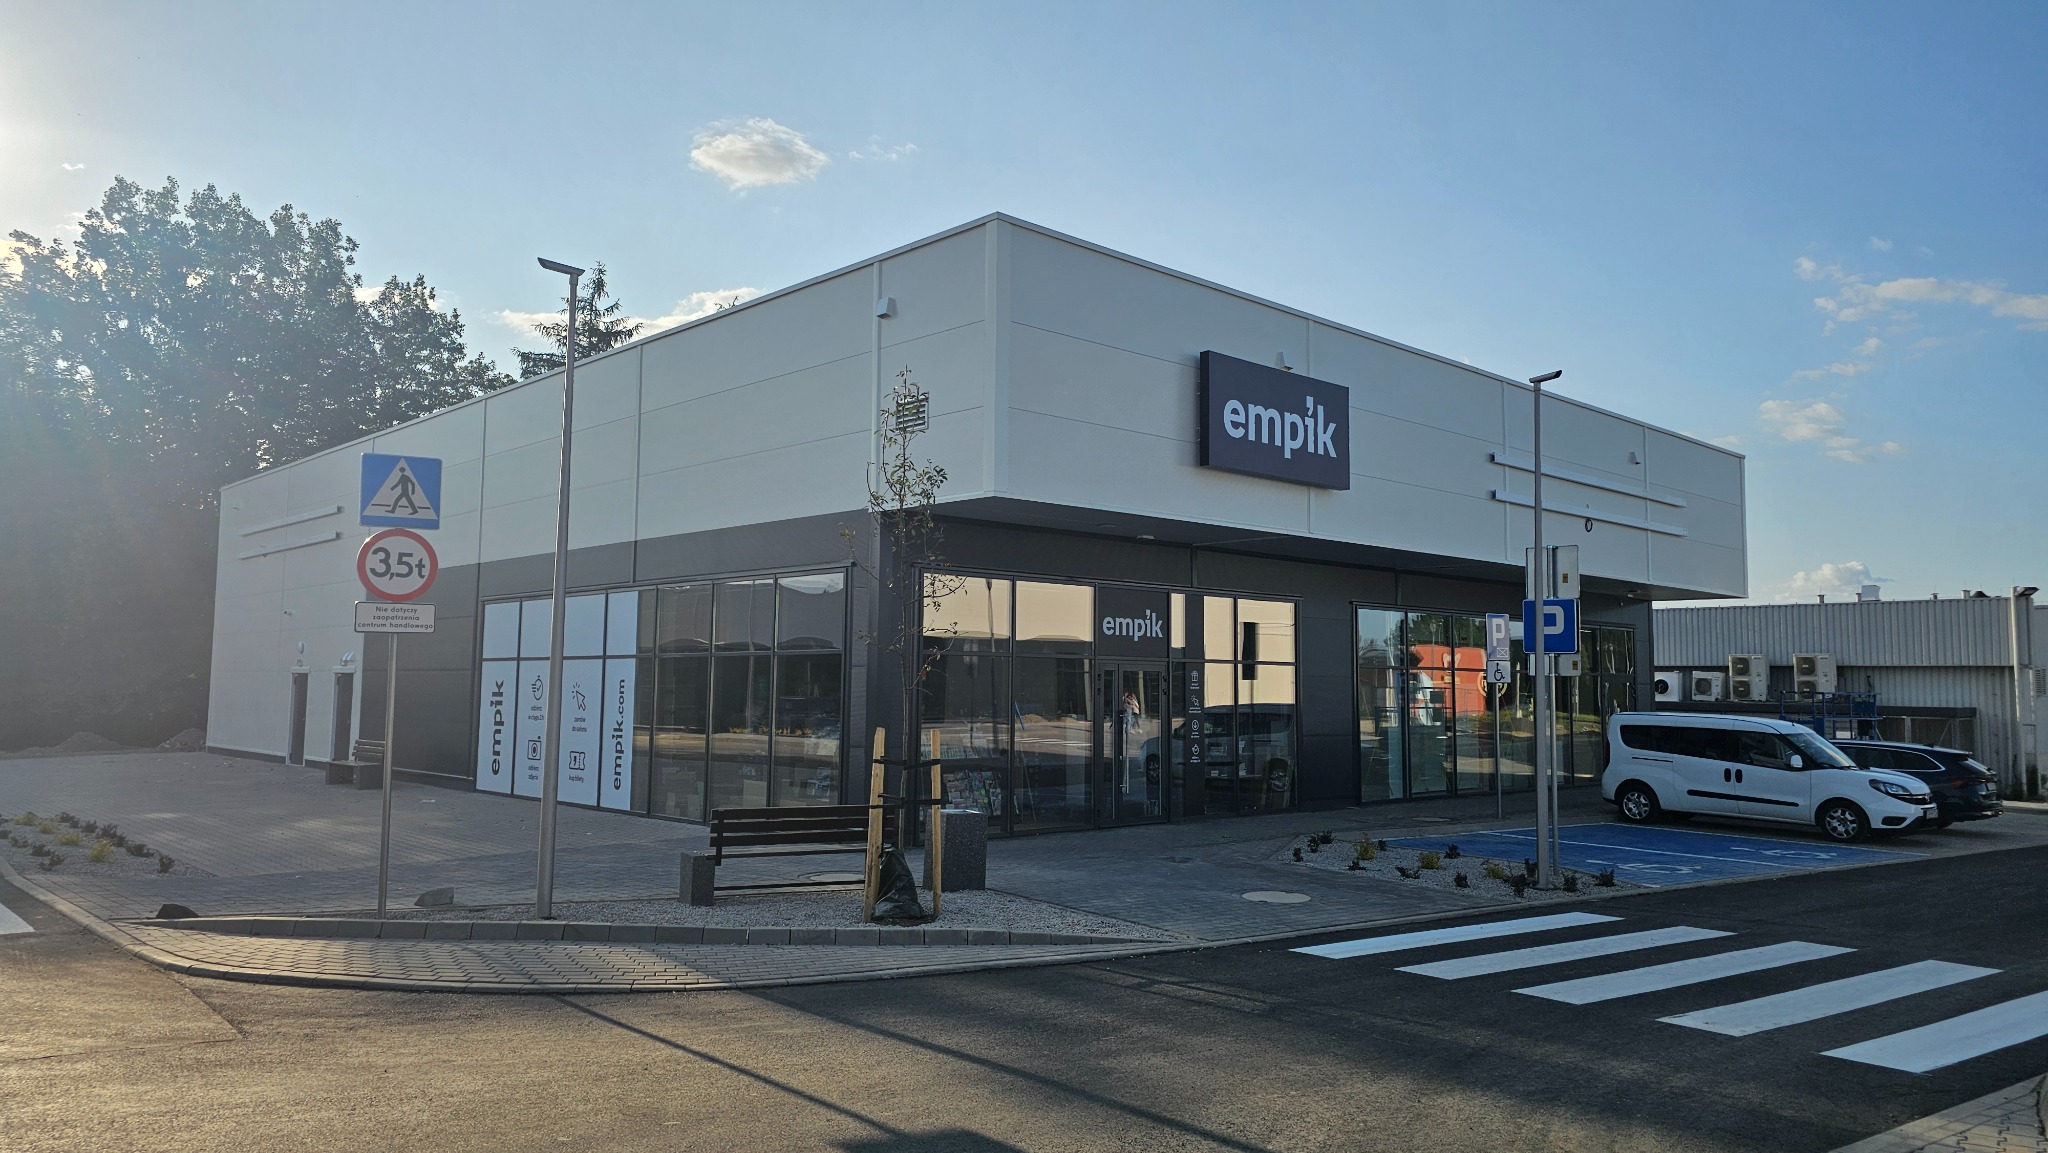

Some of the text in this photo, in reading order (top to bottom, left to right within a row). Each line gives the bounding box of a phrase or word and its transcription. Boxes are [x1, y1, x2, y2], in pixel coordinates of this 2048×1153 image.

[1223, 395, 1337, 459] empik
[369, 546, 426, 581] 3,5t
[373, 614, 420, 622] zaopatrzenia
[389, 622, 434, 631] handlowego
[390, 606, 418, 615] dotyczy
[1102, 609, 1164, 642] empik
[1491, 618, 1506, 647] P
[490, 680, 505, 776] empik
[612, 679, 626, 791] empik.com
